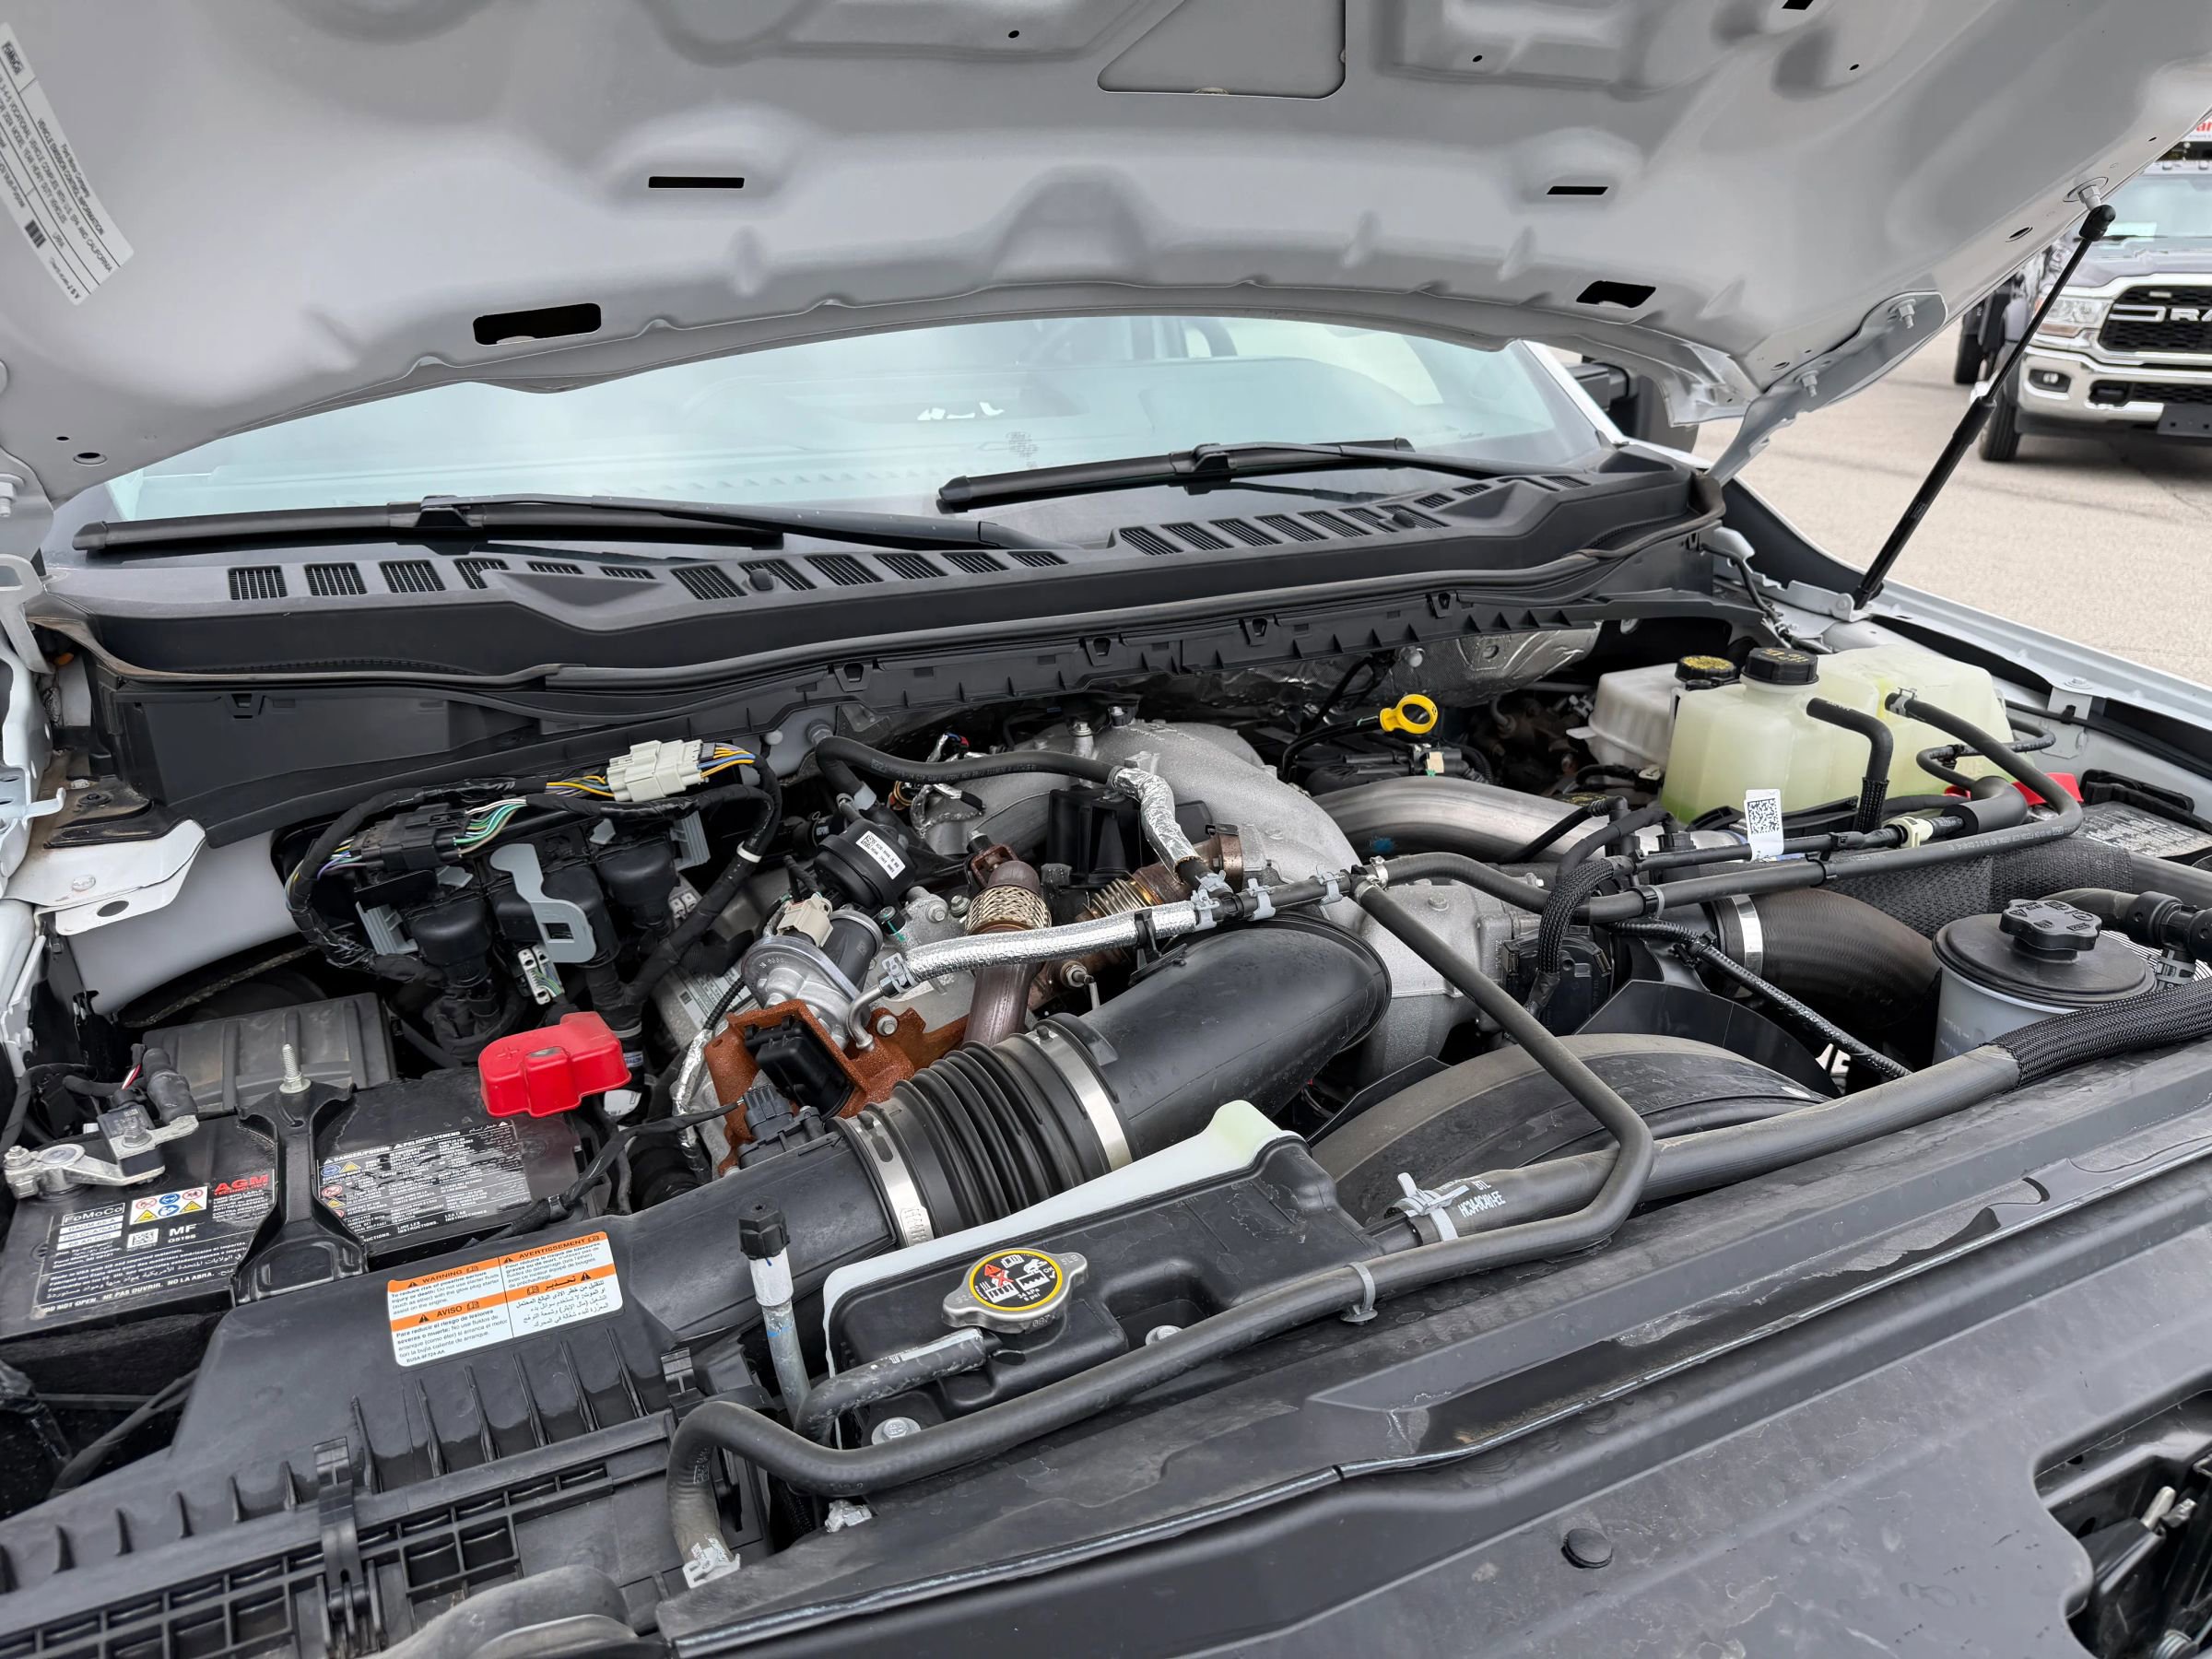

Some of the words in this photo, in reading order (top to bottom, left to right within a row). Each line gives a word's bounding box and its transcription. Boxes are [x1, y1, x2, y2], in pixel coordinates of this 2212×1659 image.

[11, 126, 24, 147] MODEL
[22, 148, 34, 164] YEAR
[29, 163, 44, 182] HEAVY
[50, 198, 66, 222] VEHICLES
[36, 119, 53, 143] VEHICLE
[49, 144, 67, 170] EMISSION
[64, 171, 80, 195] CONTROL
[78, 196, 103, 235] INFORMATION
[59, 143, 71, 157] Ford
[74, 173, 91, 196] Company
[29, 140, 44, 160] VEHICLE
[41, 162, 59, 188] COMPLIES
[55, 189, 66, 203] WITH
[77, 225, 88, 240] AND
[88, 239, 111, 272] CALIFORNIA
[334, 1146, 389, 1161] DANGER/POISON
[404, 1131, 460, 1147] PELIGRO/VENENO
[213, 1174, 268, 1192] AGM
[214, 1182, 268, 1195] TECHNOLOGY
[1471, 1178, 1491, 1191] BTL
[63, 1206, 122, 1223] FoMoCo
[168, 1224, 197, 1235] MF
[397, 1221, 438, 1232] INSTRUCTIONS.
[422, 1270, 462, 1283] WARNING
[518, 1238, 584, 1258] AVERTISSEMENT
[519, 1256, 539, 1265] réduire
[547, 1251, 564, 1259] risque
[573, 1242, 600, 1251] blessures
[505, 1265, 525, 1274] graves
[506, 1270, 524, 1278] fluides
[529, 1269, 547, 1277] moteur
[547, 1264, 566, 1274] équipé
[574, 1256, 595, 1266] bougies
[1041, 1265, 1054, 1274] OK
[55, 1301, 75, 1310] NOT
[74, 1297, 97, 1306] OPEN.
[131, 1283, 162, 1292] OUVRIR.
[191, 1271, 214, 1280] ABRA.
[391, 1295, 408, 1304] injury
[417, 1288, 436, 1297] death:
[484, 1272, 499, 1280] fluids
[398, 1288, 419, 1296] reduce
[465, 1270, 487, 1279] serious
[1026, 1287, 1040, 1295] kPa
[391, 1301, 407, 1310] (such
[416, 1295, 433, 1303] ether)
[469, 1282, 481, 1290] plug
[482, 1277, 499, 1286] starter
[428, 1297, 448, 1306] engine.
[1029, 1291, 1041, 1300] psi
[435, 1306, 462, 1316] AVISO
[410, 1324, 432, 1334] reducir
[440, 1317, 460, 1328] riesgo
[468, 1310, 493, 1318] lesiones
[426, 1326, 450, 1336] muerte:
[472, 1316, 489, 1324] fluidos
[398, 1342, 423, 1351] arranque
[424, 1335, 442, 1345] (como
[463, 1324, 485, 1334] arranca
[491, 1318, 507, 1326] motor
[431, 1339, 453, 1349] caliente
[463, 1331, 488, 1341] arranque.
